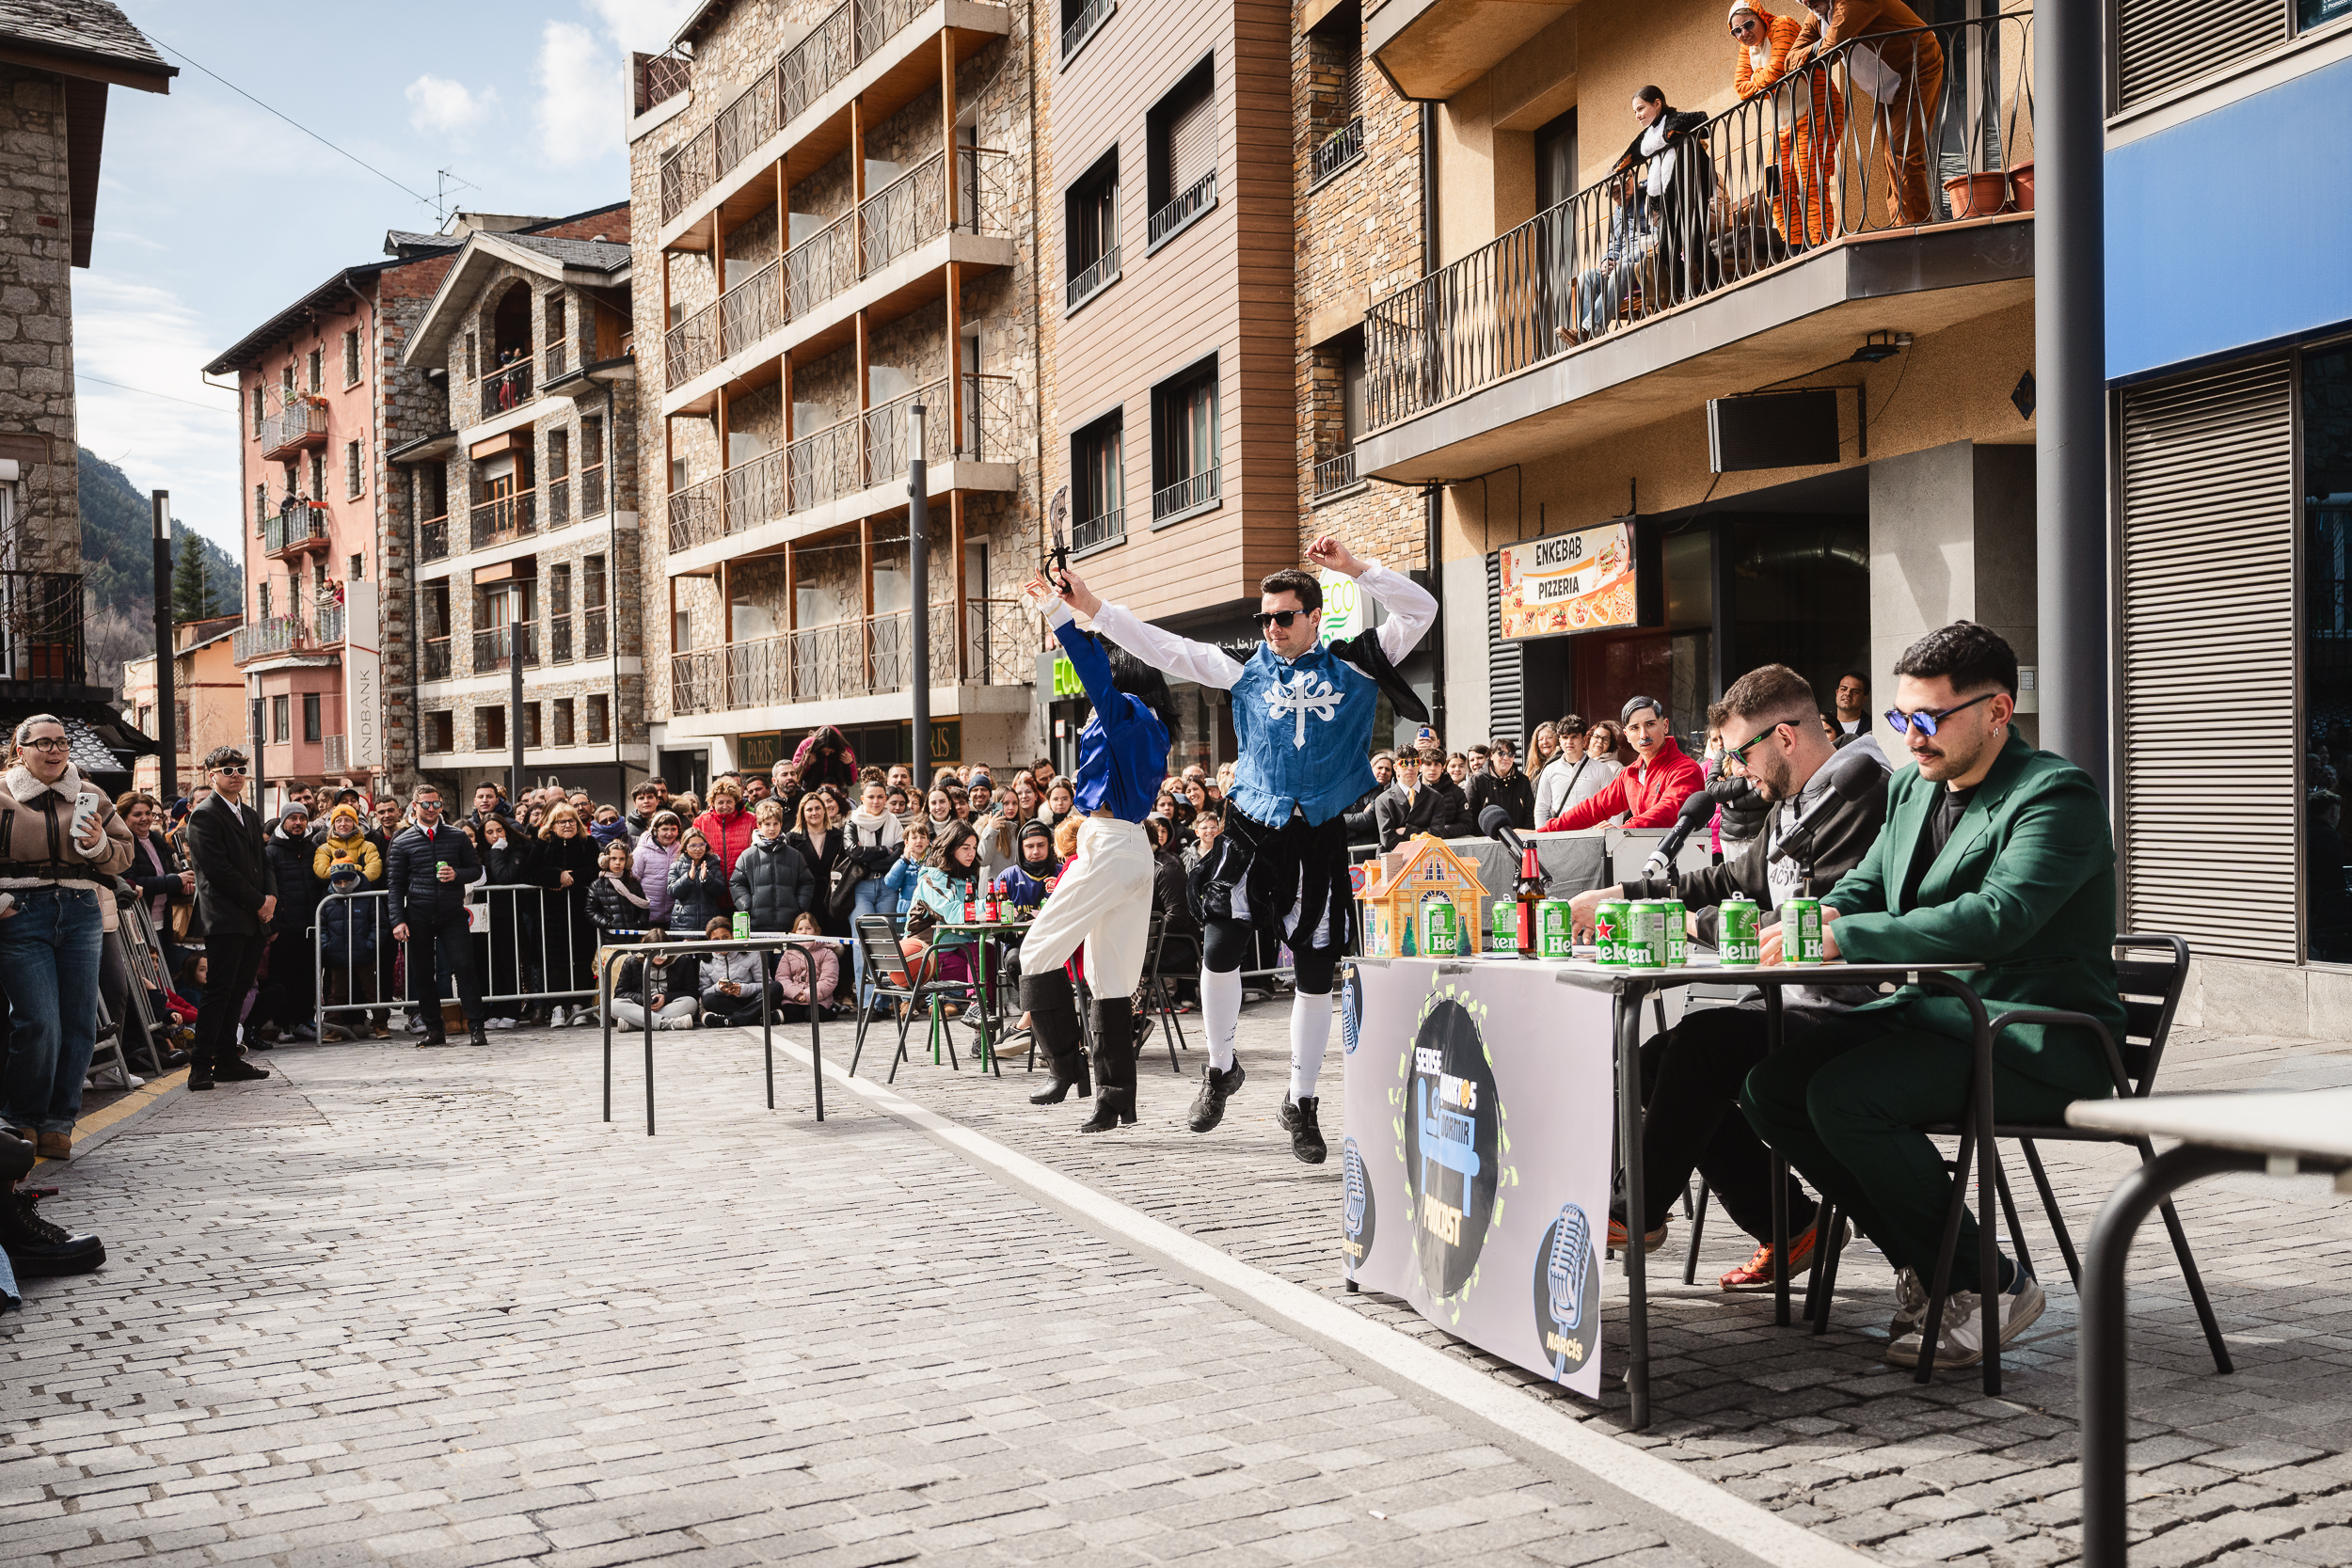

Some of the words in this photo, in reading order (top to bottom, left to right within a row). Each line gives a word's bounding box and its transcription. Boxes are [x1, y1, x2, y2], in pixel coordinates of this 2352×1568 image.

[1535, 535, 1582, 566] ENKEBAB
[1538, 576, 1580, 600] PIZZERIA
[359, 670, 373, 763] ANDBANK
[748, 739, 773, 765] PARIS
[930, 727, 949, 757] RIS
[1719, 941, 1760, 960] Hein
[1415, 1046, 1442, 1077] SENSE
[1441, 1113, 1470, 1146] DORMIR
[1423, 1192, 1462, 1248] PODCAST
